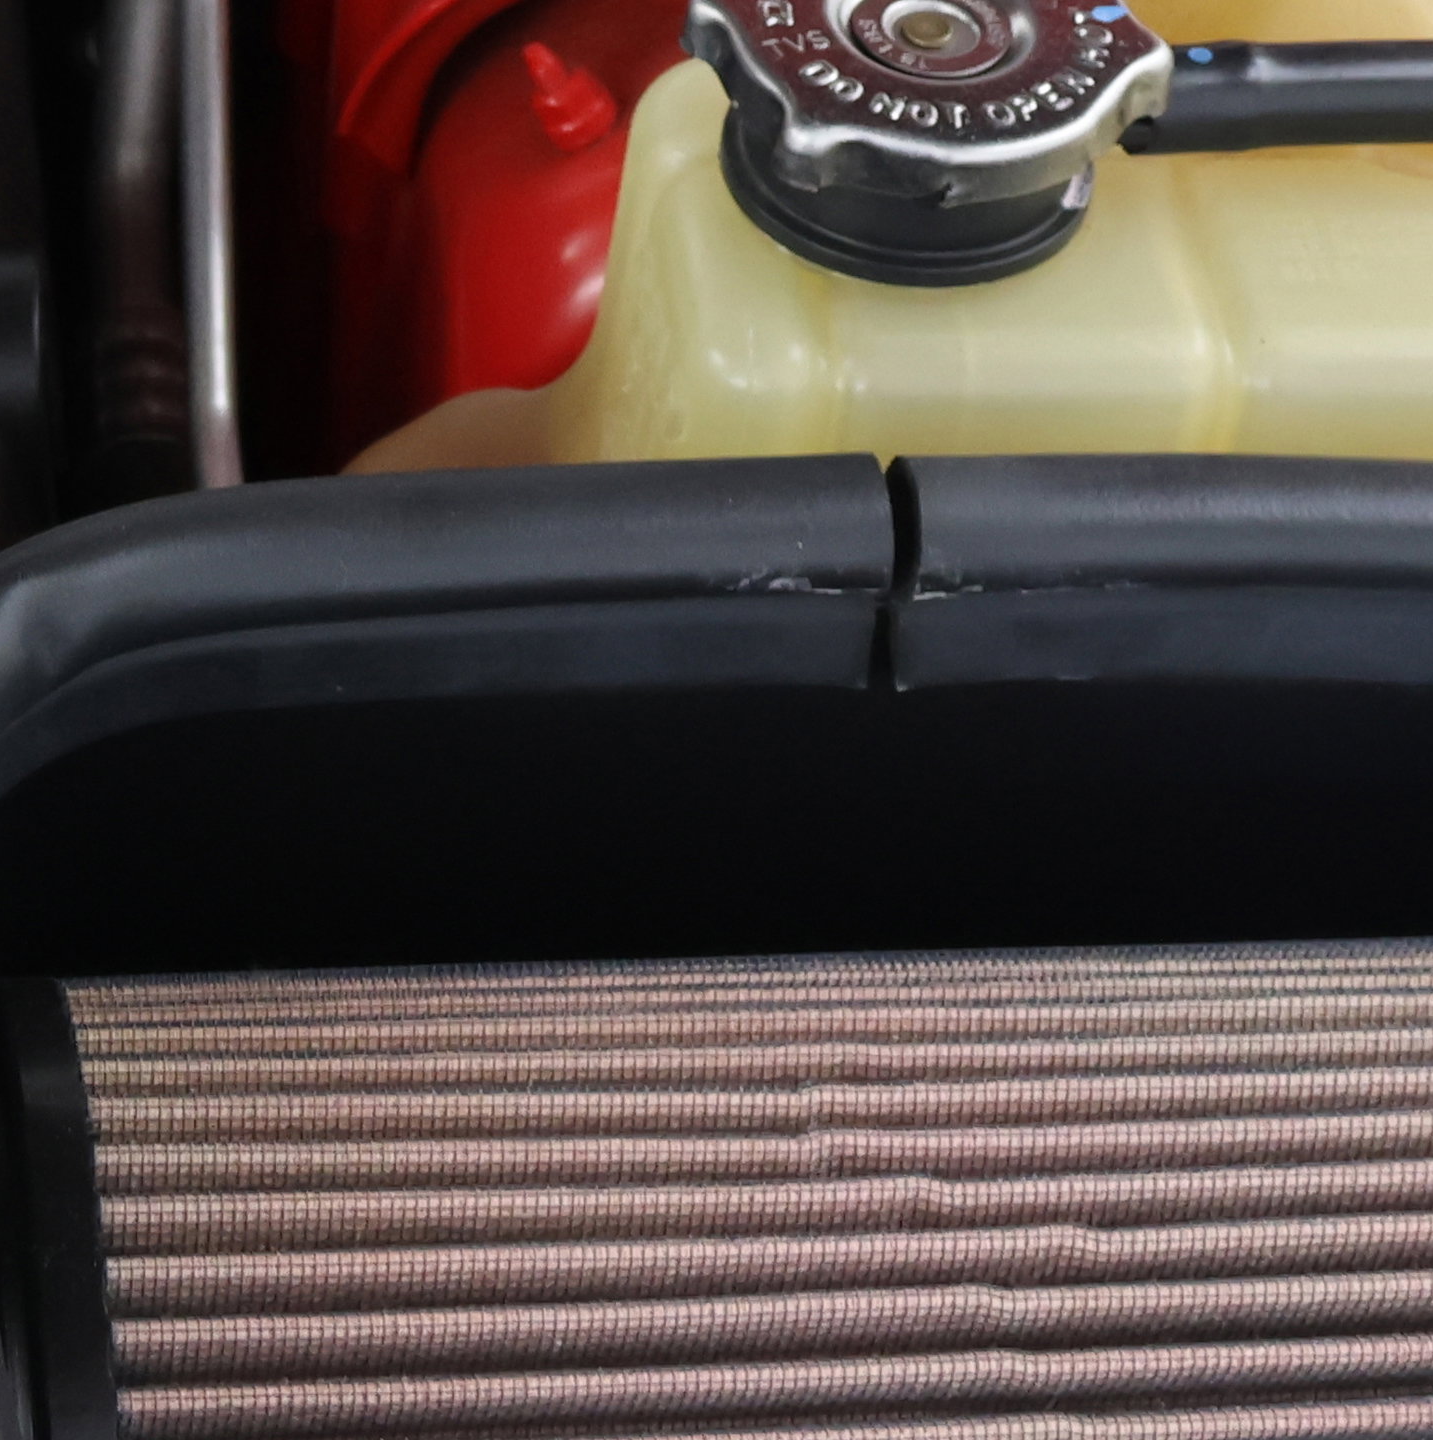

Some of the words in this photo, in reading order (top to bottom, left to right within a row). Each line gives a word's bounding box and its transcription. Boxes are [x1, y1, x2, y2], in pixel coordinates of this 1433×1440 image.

[761, 30, 830, 57] TVS
[799, 60, 864, 103] DO
[870, 91, 970, 129] NOT
[982, 67, 1096, 127] OPEN
